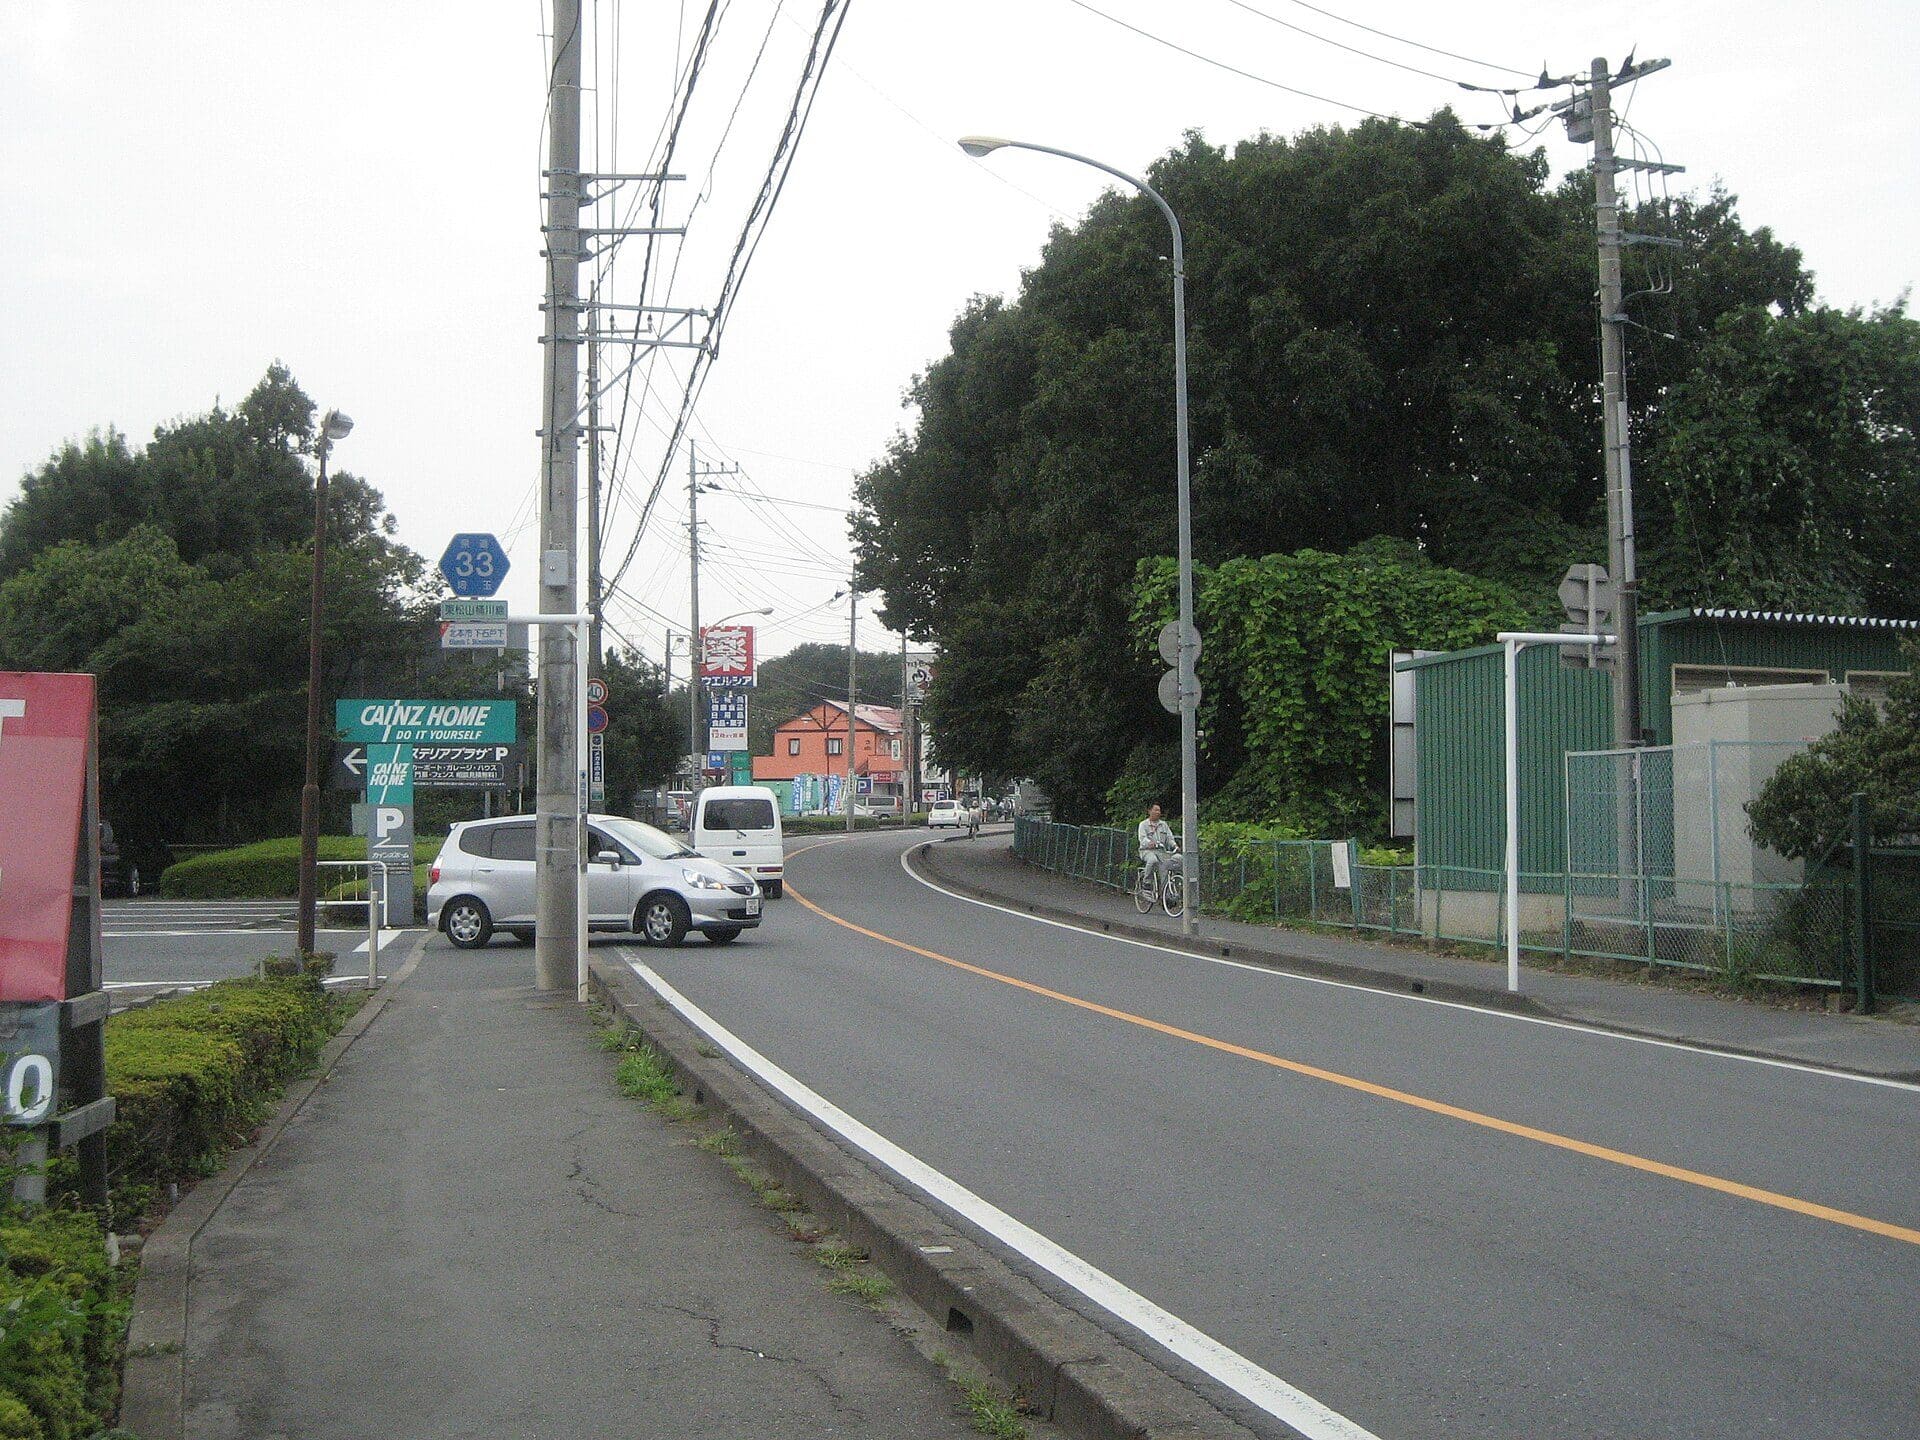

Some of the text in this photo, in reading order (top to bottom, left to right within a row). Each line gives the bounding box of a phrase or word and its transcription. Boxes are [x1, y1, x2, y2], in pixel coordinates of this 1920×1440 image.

[455, 551, 494, 572] 33
[706, 629, 748, 672] 薬
[701, 675, 753, 687] ウエルシア
[360, 704, 491, 726] CAINZ HOME
[396, 730, 483, 740] DO IT YOURSELF
[495, 747, 509, 760] P
[373, 762, 409, 774] CAINZ
[370, 774, 406, 786] HOME
[857, 780, 868, 793] P
[376, 807, 404, 837] P
